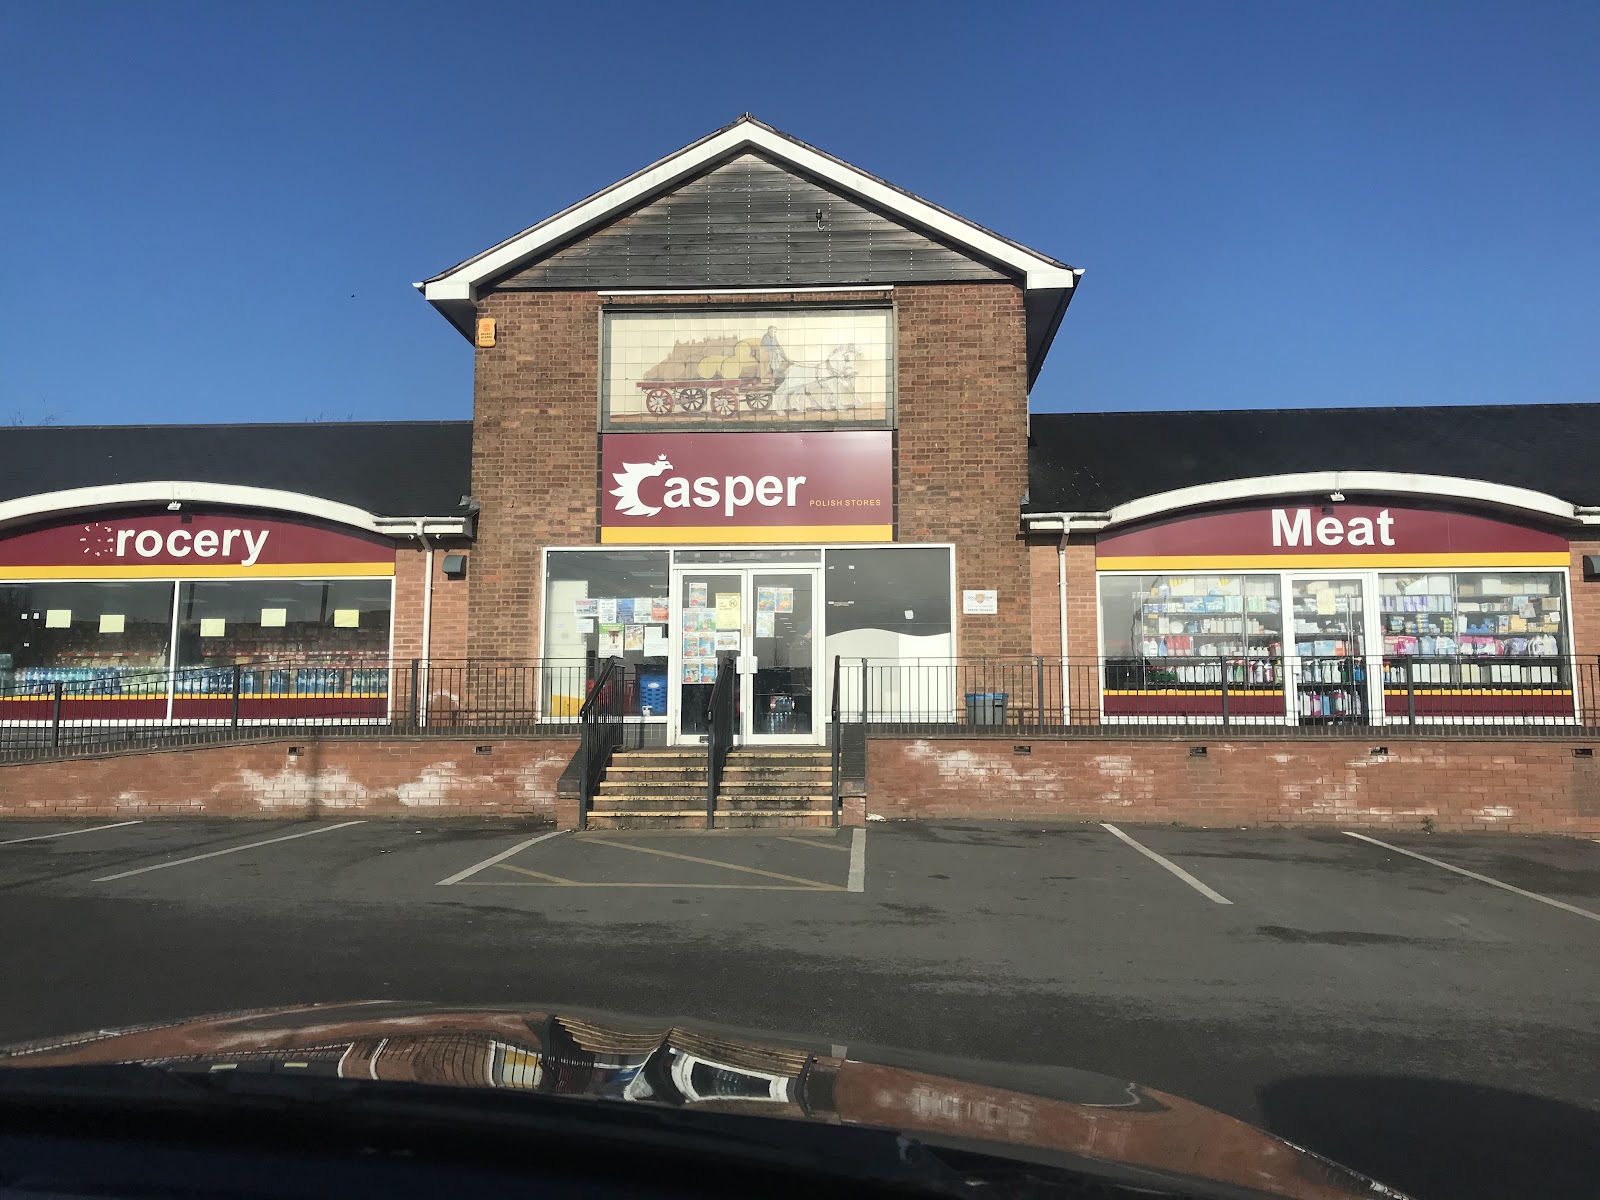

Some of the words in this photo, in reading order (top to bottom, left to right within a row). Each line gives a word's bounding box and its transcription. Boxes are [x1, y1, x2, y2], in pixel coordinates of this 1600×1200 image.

[608, 453, 807, 517] Casper
[809, 499, 842, 507] POLISH
[845, 499, 881, 507] STORES
[1271, 508, 1396, 547] Meat
